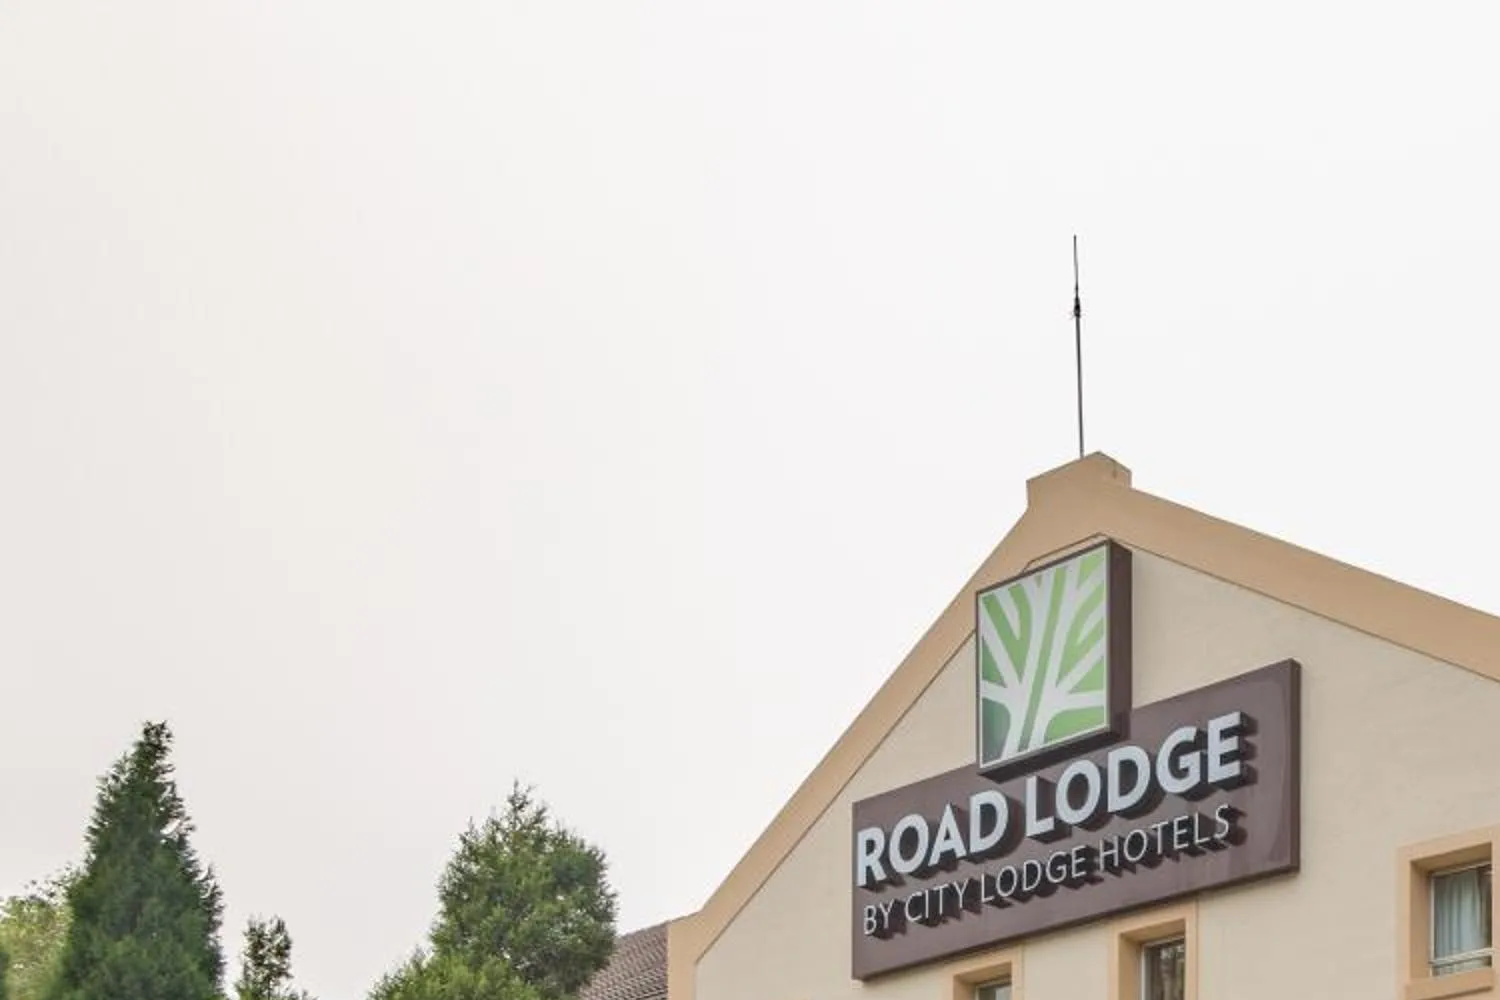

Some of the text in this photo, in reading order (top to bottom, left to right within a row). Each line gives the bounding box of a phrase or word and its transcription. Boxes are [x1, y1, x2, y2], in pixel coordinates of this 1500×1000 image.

[857, 711, 1242, 887] ROAD LODGE
[863, 803, 1230, 935] BY CITY LODGE HOTELS
